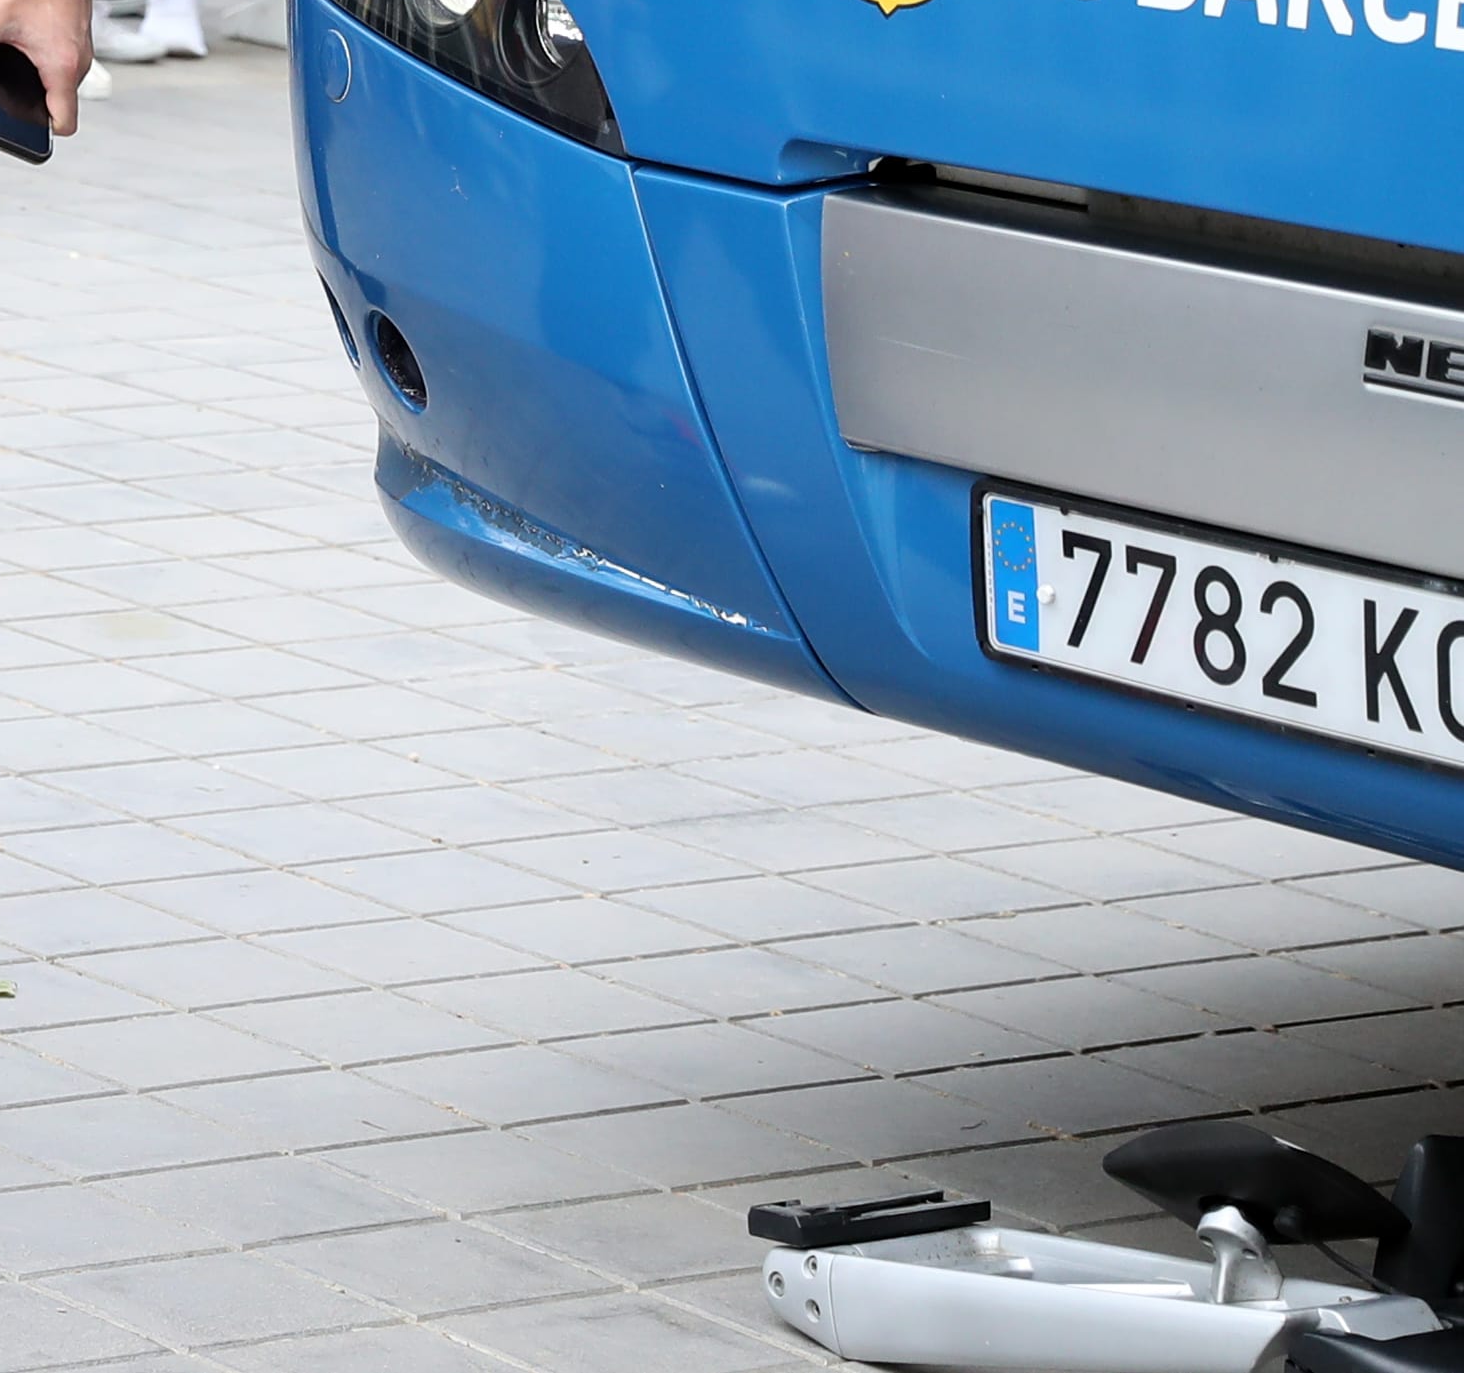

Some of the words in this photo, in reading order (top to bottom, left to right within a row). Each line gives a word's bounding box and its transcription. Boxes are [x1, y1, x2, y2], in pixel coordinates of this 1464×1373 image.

[1364, 329, 1464, 385] NE
[1007, 590, 1026, 625] E
[1061, 530, 1318, 708] 7782
